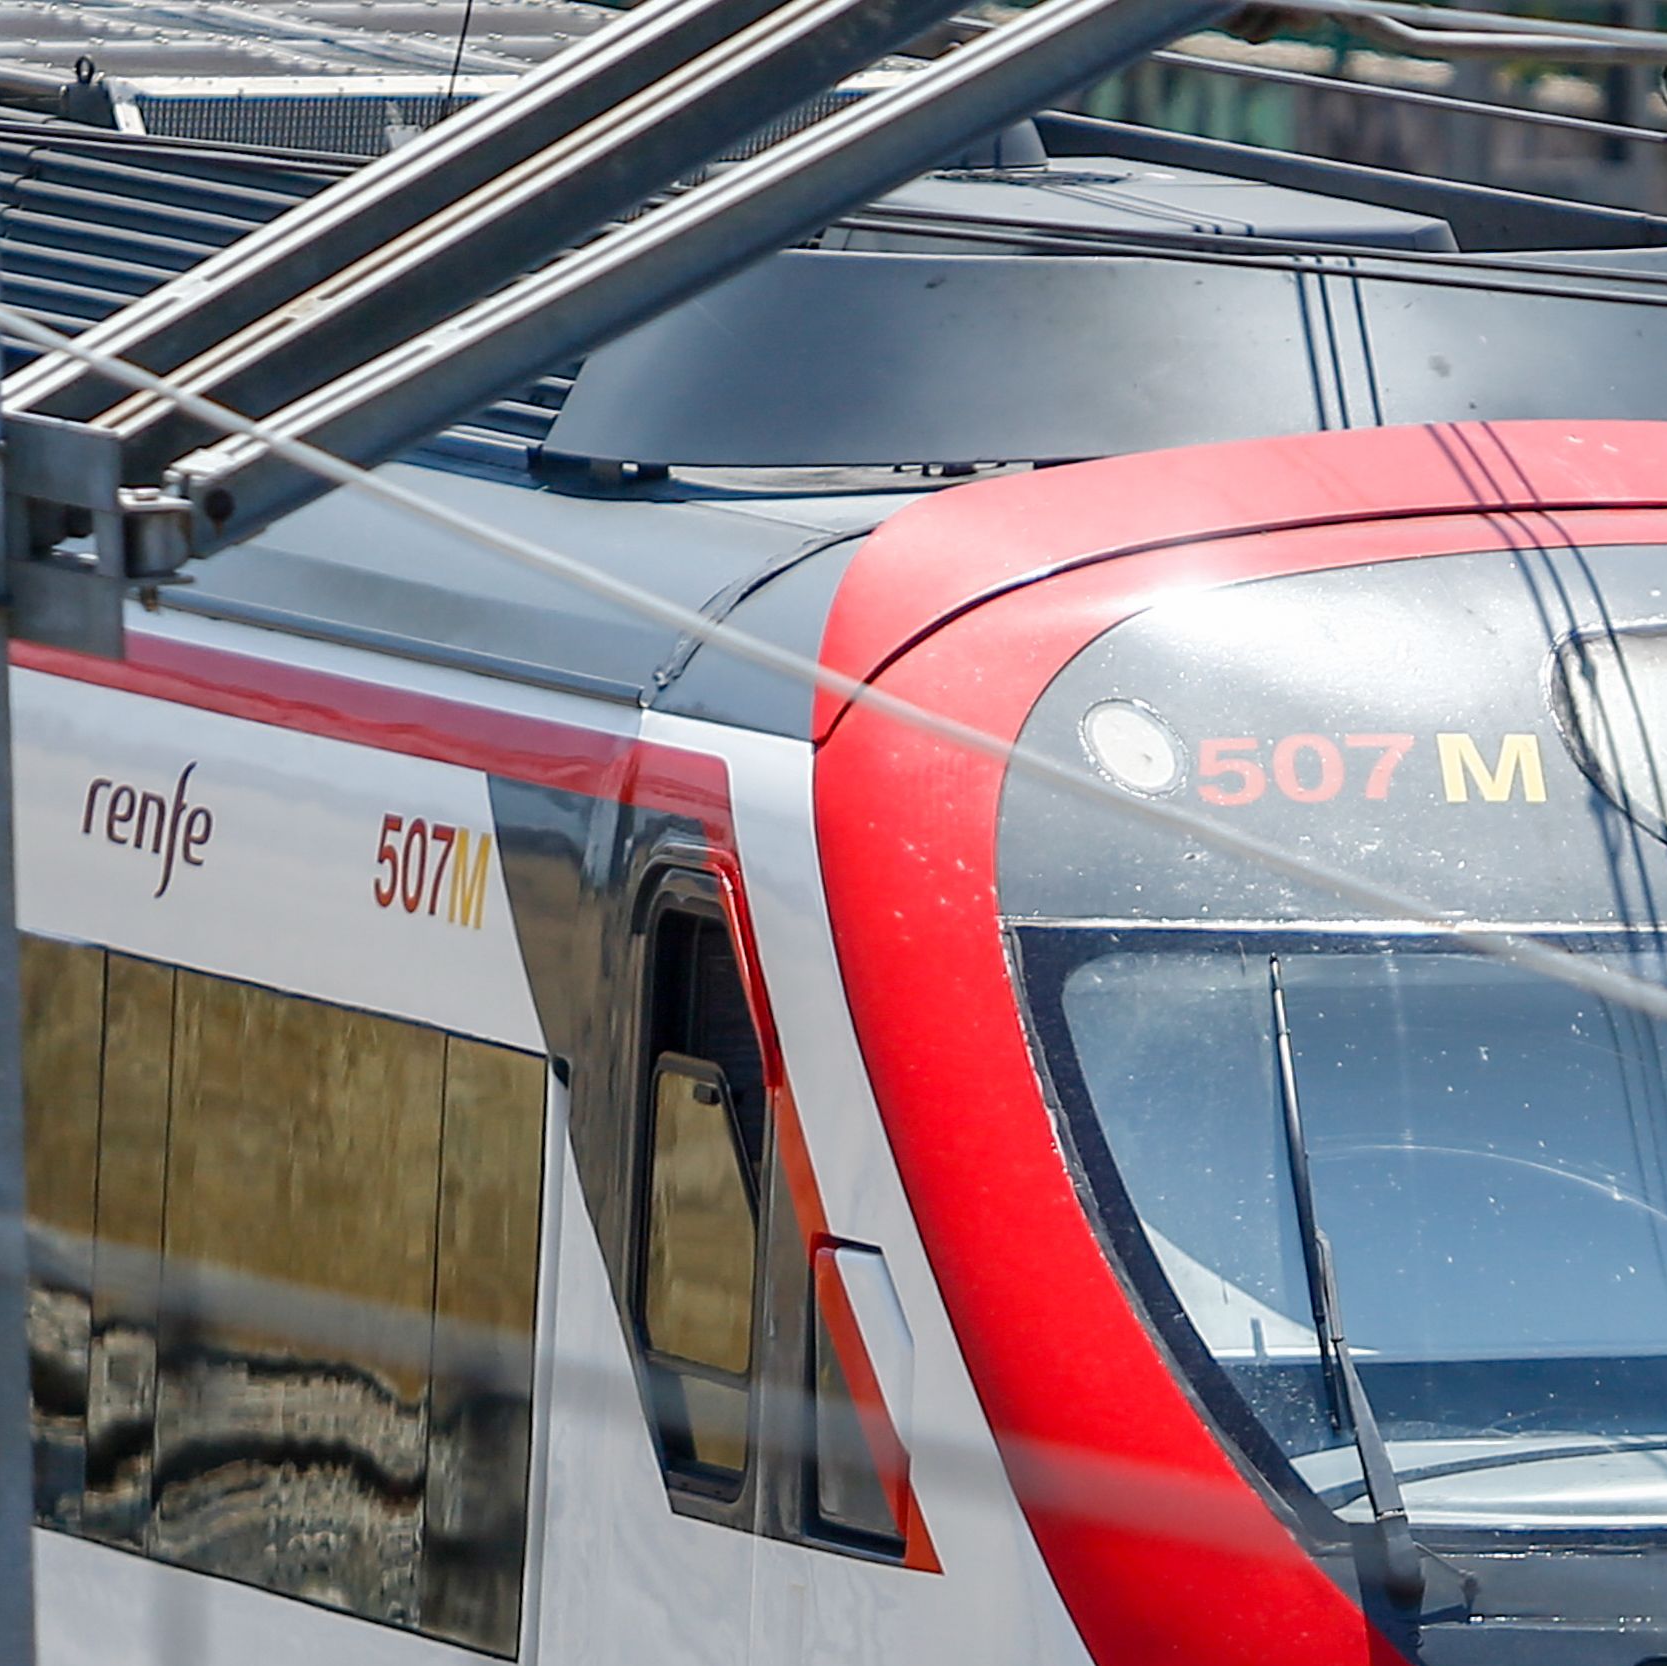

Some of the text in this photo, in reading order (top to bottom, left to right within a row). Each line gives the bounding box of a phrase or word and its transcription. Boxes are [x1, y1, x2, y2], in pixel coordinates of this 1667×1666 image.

[1196, 732, 1548, 807] 507 M
[81, 760, 213, 899] renfe
